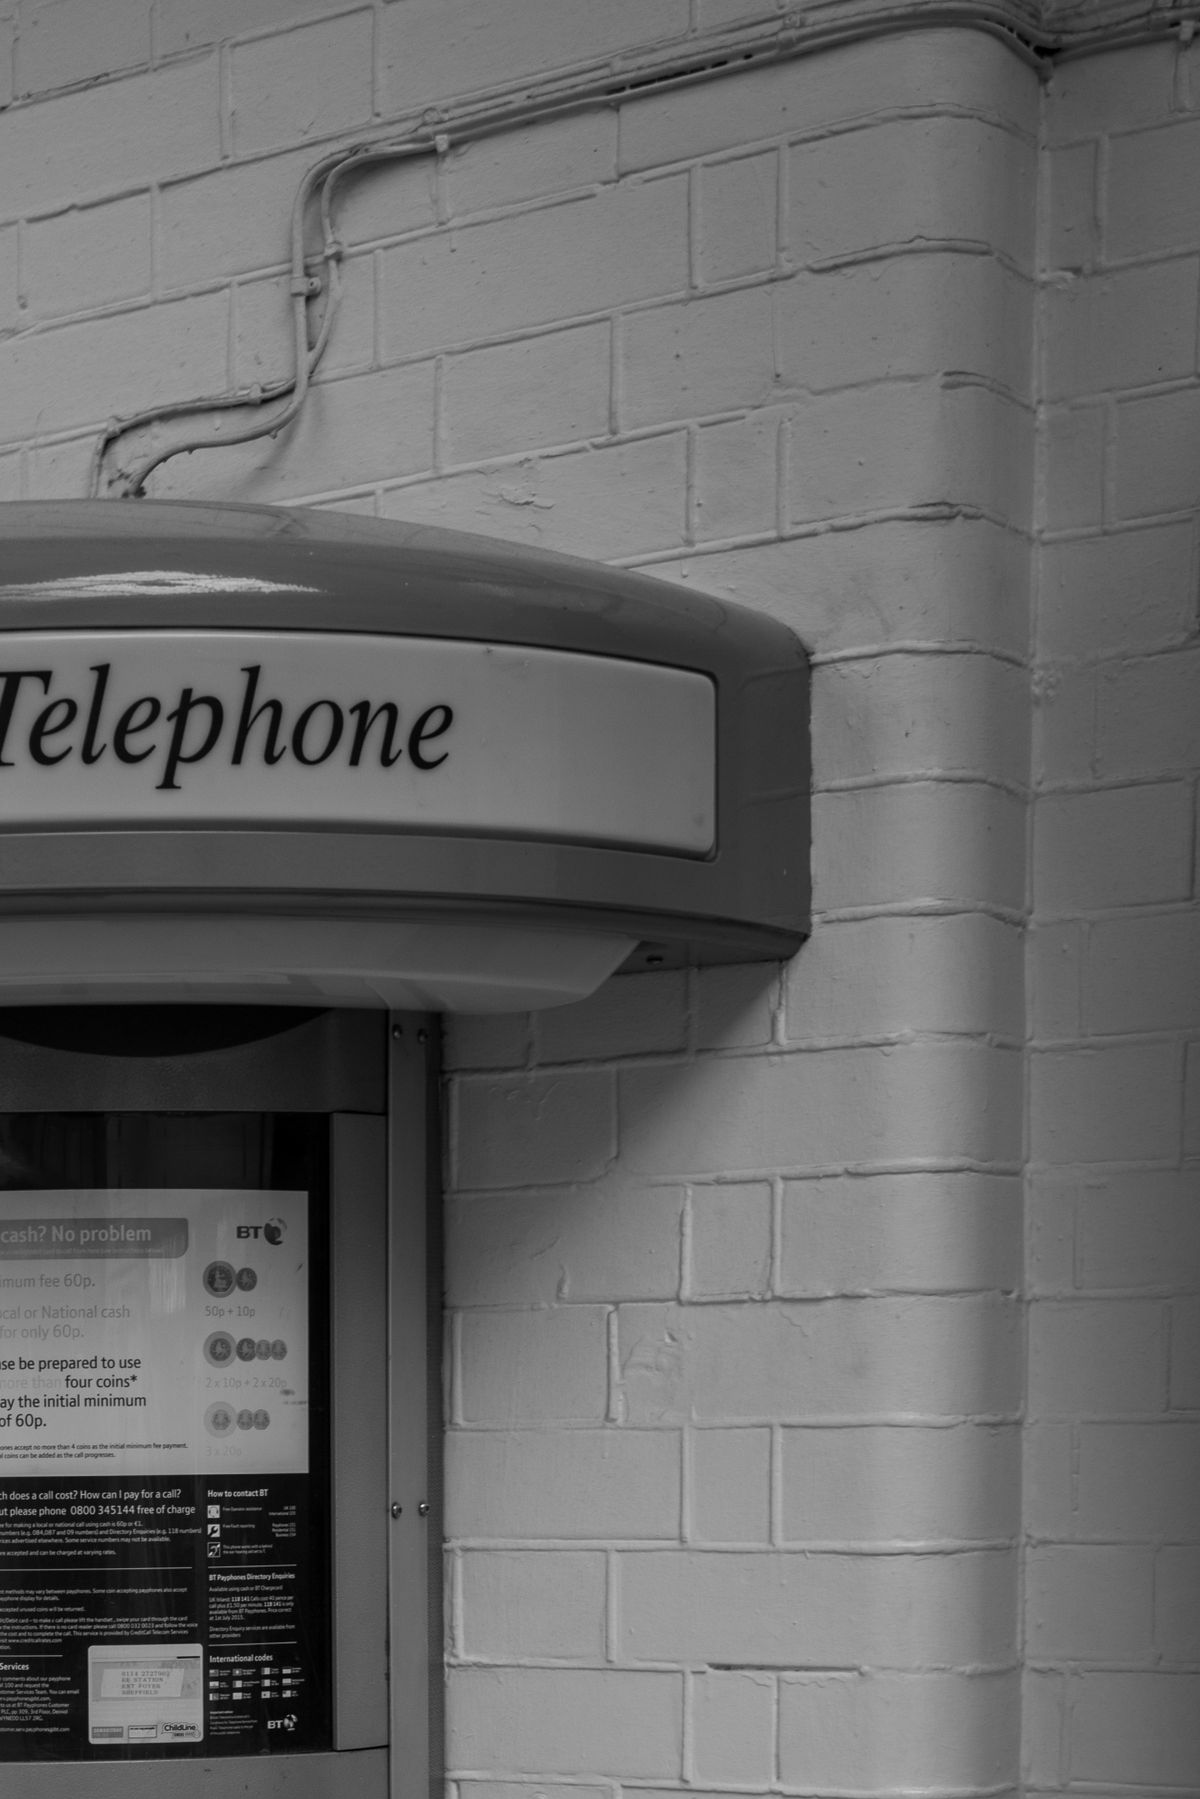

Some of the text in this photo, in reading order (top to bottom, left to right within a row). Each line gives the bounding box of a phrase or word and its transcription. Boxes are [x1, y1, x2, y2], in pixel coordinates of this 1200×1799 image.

[0, 1226, 47, 1243] cash?
[51, 1226, 75, 1242] No
[79, 1225, 151, 1246] problem
[236, 1226, 263, 1239] BT
[37, 1274, 61, 1287] fee
[63, 1274, 95, 1290] 60p.
[22, 1309, 39, 1320] or
[41, 1305, 98, 1319] National
[99, 1305, 130, 1319] cash
[205, 1306, 225, 1319] 50p
[235, 1305, 255, 1319] 10p
[19, 1325, 50, 1342] only
[52, 1325, 85, 1341] 60p.
[18, 1357, 35, 1370] be
[38, 1356, 97, 1372] prepared
[100, 1356, 115, 1369] to
[118, 1358, 141, 1368] use
[30, 1376, 61, 1389] than
[64, 1376, 92, 1388] four
[17, 1396, 40, 1408] the
[43, 1395, 80, 1408] initial
[83, 1394, 147, 1407] minimum
[15, 1414, 47, 1430] 60p.
[9, 1491, 30, 1500] does
[38, 1490, 53, 1500] call
[54, 1490, 78, 1500] cost?
[79, 1490, 100, 1499] How
[118, 1489, 121, 1499] I
[123, 1492, 139, 1501] pay
[140, 1489, 153, 1499] for
[161, 1489, 182, 1498] call?
[207, 1490, 223, 1498] How
[232, 1489, 258, 1497] contact
[9, 1506, 37, 1518] please
[38, 1506, 66, 1518] phone
[70, 1506, 95, 1515] 0800
[98, 1505, 134, 1515] 345144
[136, 1505, 154, 1514] free
[155, 1505, 165, 1514] of
[166, 1505, 196, 1516] charge
[216, 1574, 246, 1582] Payphones
[246, 1573, 271, 1582] Directory
[271, 1573, 295, 1581] Enquiries
[209, 1654, 272, 1663] International codes
[164, 1724, 197, 1733] ChildLine
[267, 1720, 284, 1730] BT
